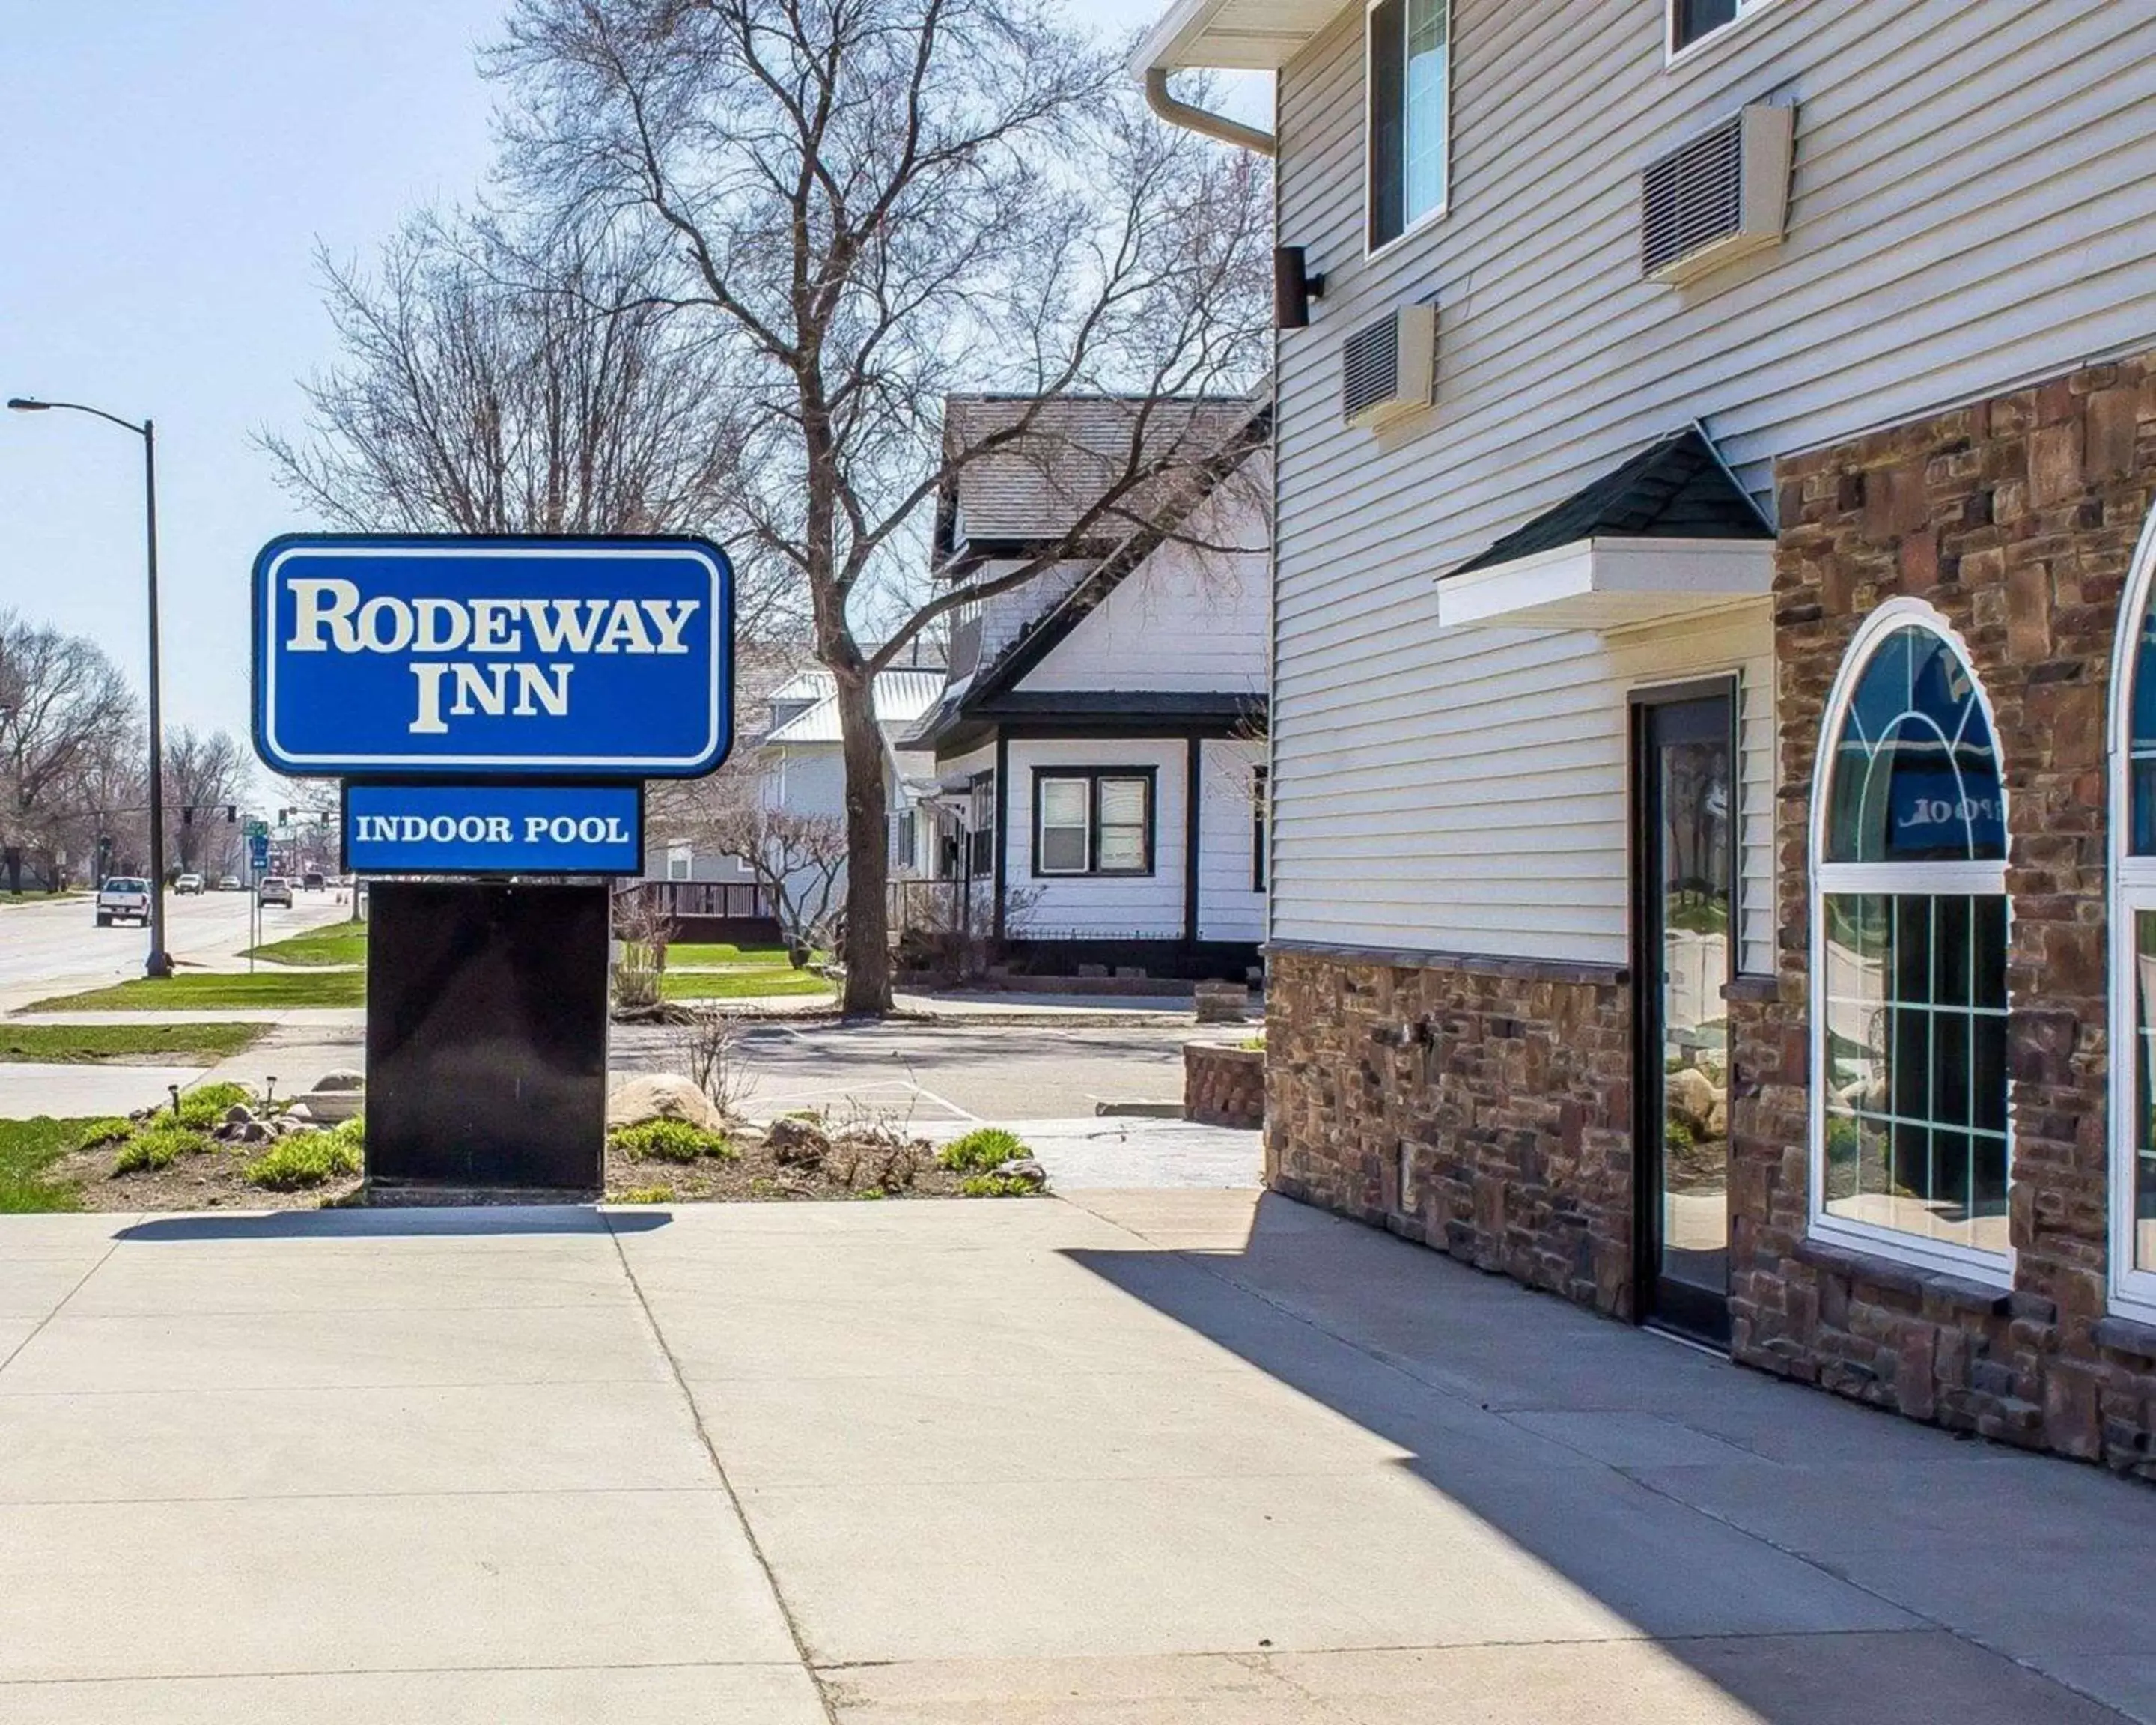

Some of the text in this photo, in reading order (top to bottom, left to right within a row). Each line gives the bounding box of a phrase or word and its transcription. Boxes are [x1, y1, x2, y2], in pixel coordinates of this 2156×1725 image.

[287, 579, 700, 654] RODEWAY
[409, 663, 574, 734] INN
[356, 815, 629, 843] INDOOR POOL
